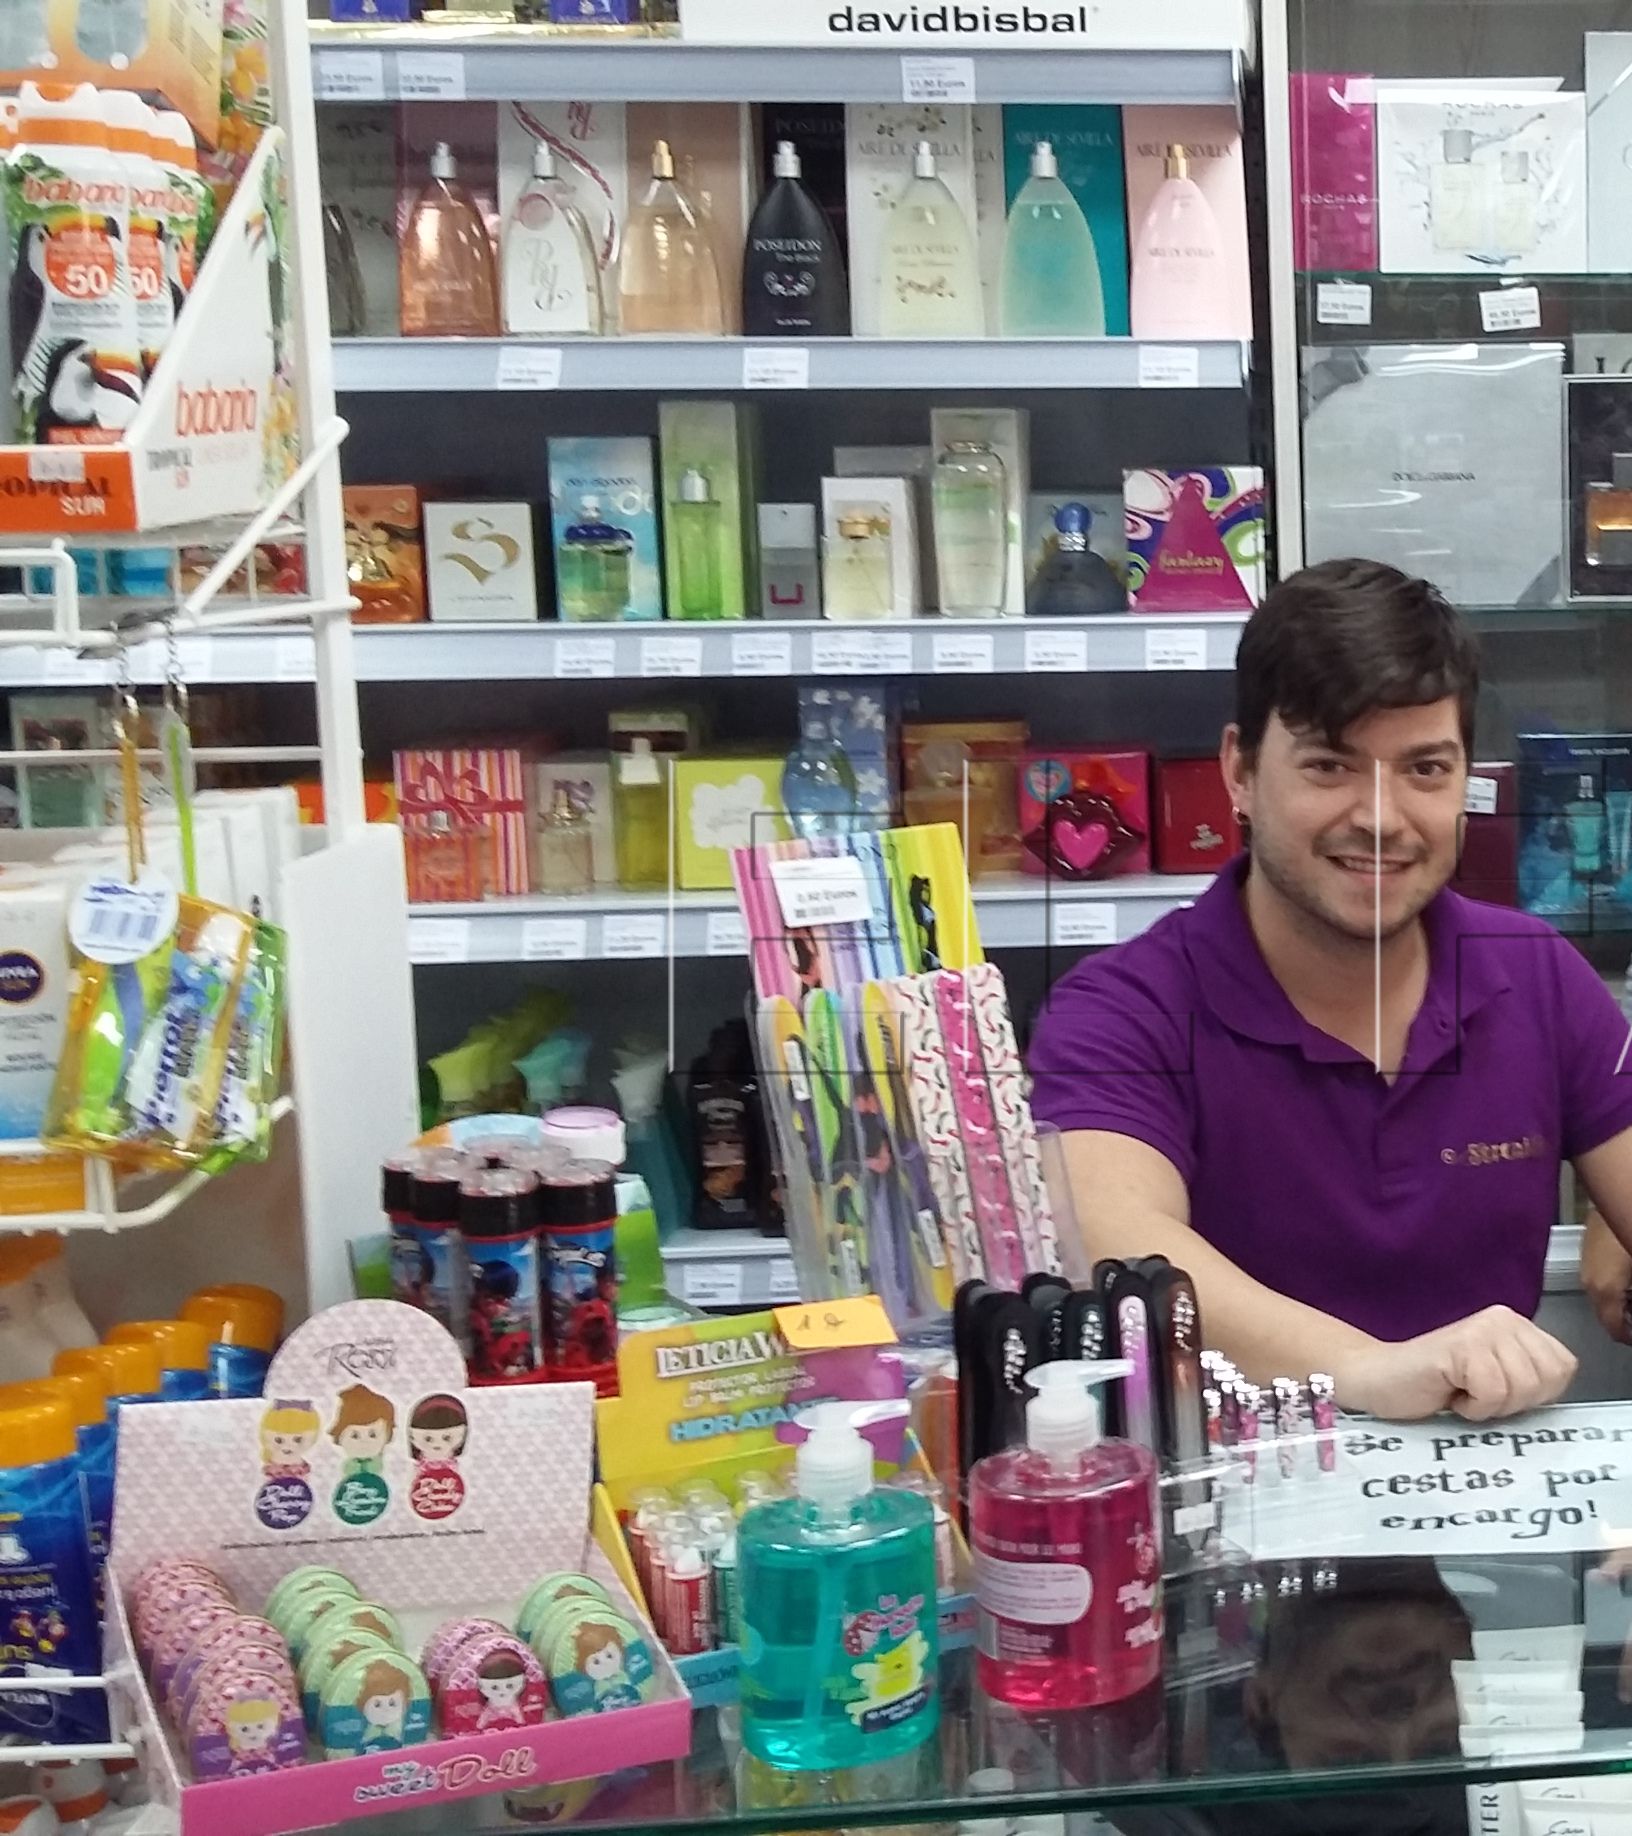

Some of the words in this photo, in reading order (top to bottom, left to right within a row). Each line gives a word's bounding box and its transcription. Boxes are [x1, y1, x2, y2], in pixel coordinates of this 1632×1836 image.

[828, 5, 1088, 33] davidbisbal
[65, 264, 109, 296] 50
[60, 495, 107, 517] SUN
[1344, 1430, 1404, 1456] Se
[1361, 1465, 1516, 1499] cestas
[1540, 1463, 1621, 1497] por
[1379, 1499, 1600, 1540] encargo!
[354, 1770, 440, 1803] sweet
[438, 1746, 537, 1793] Doll
